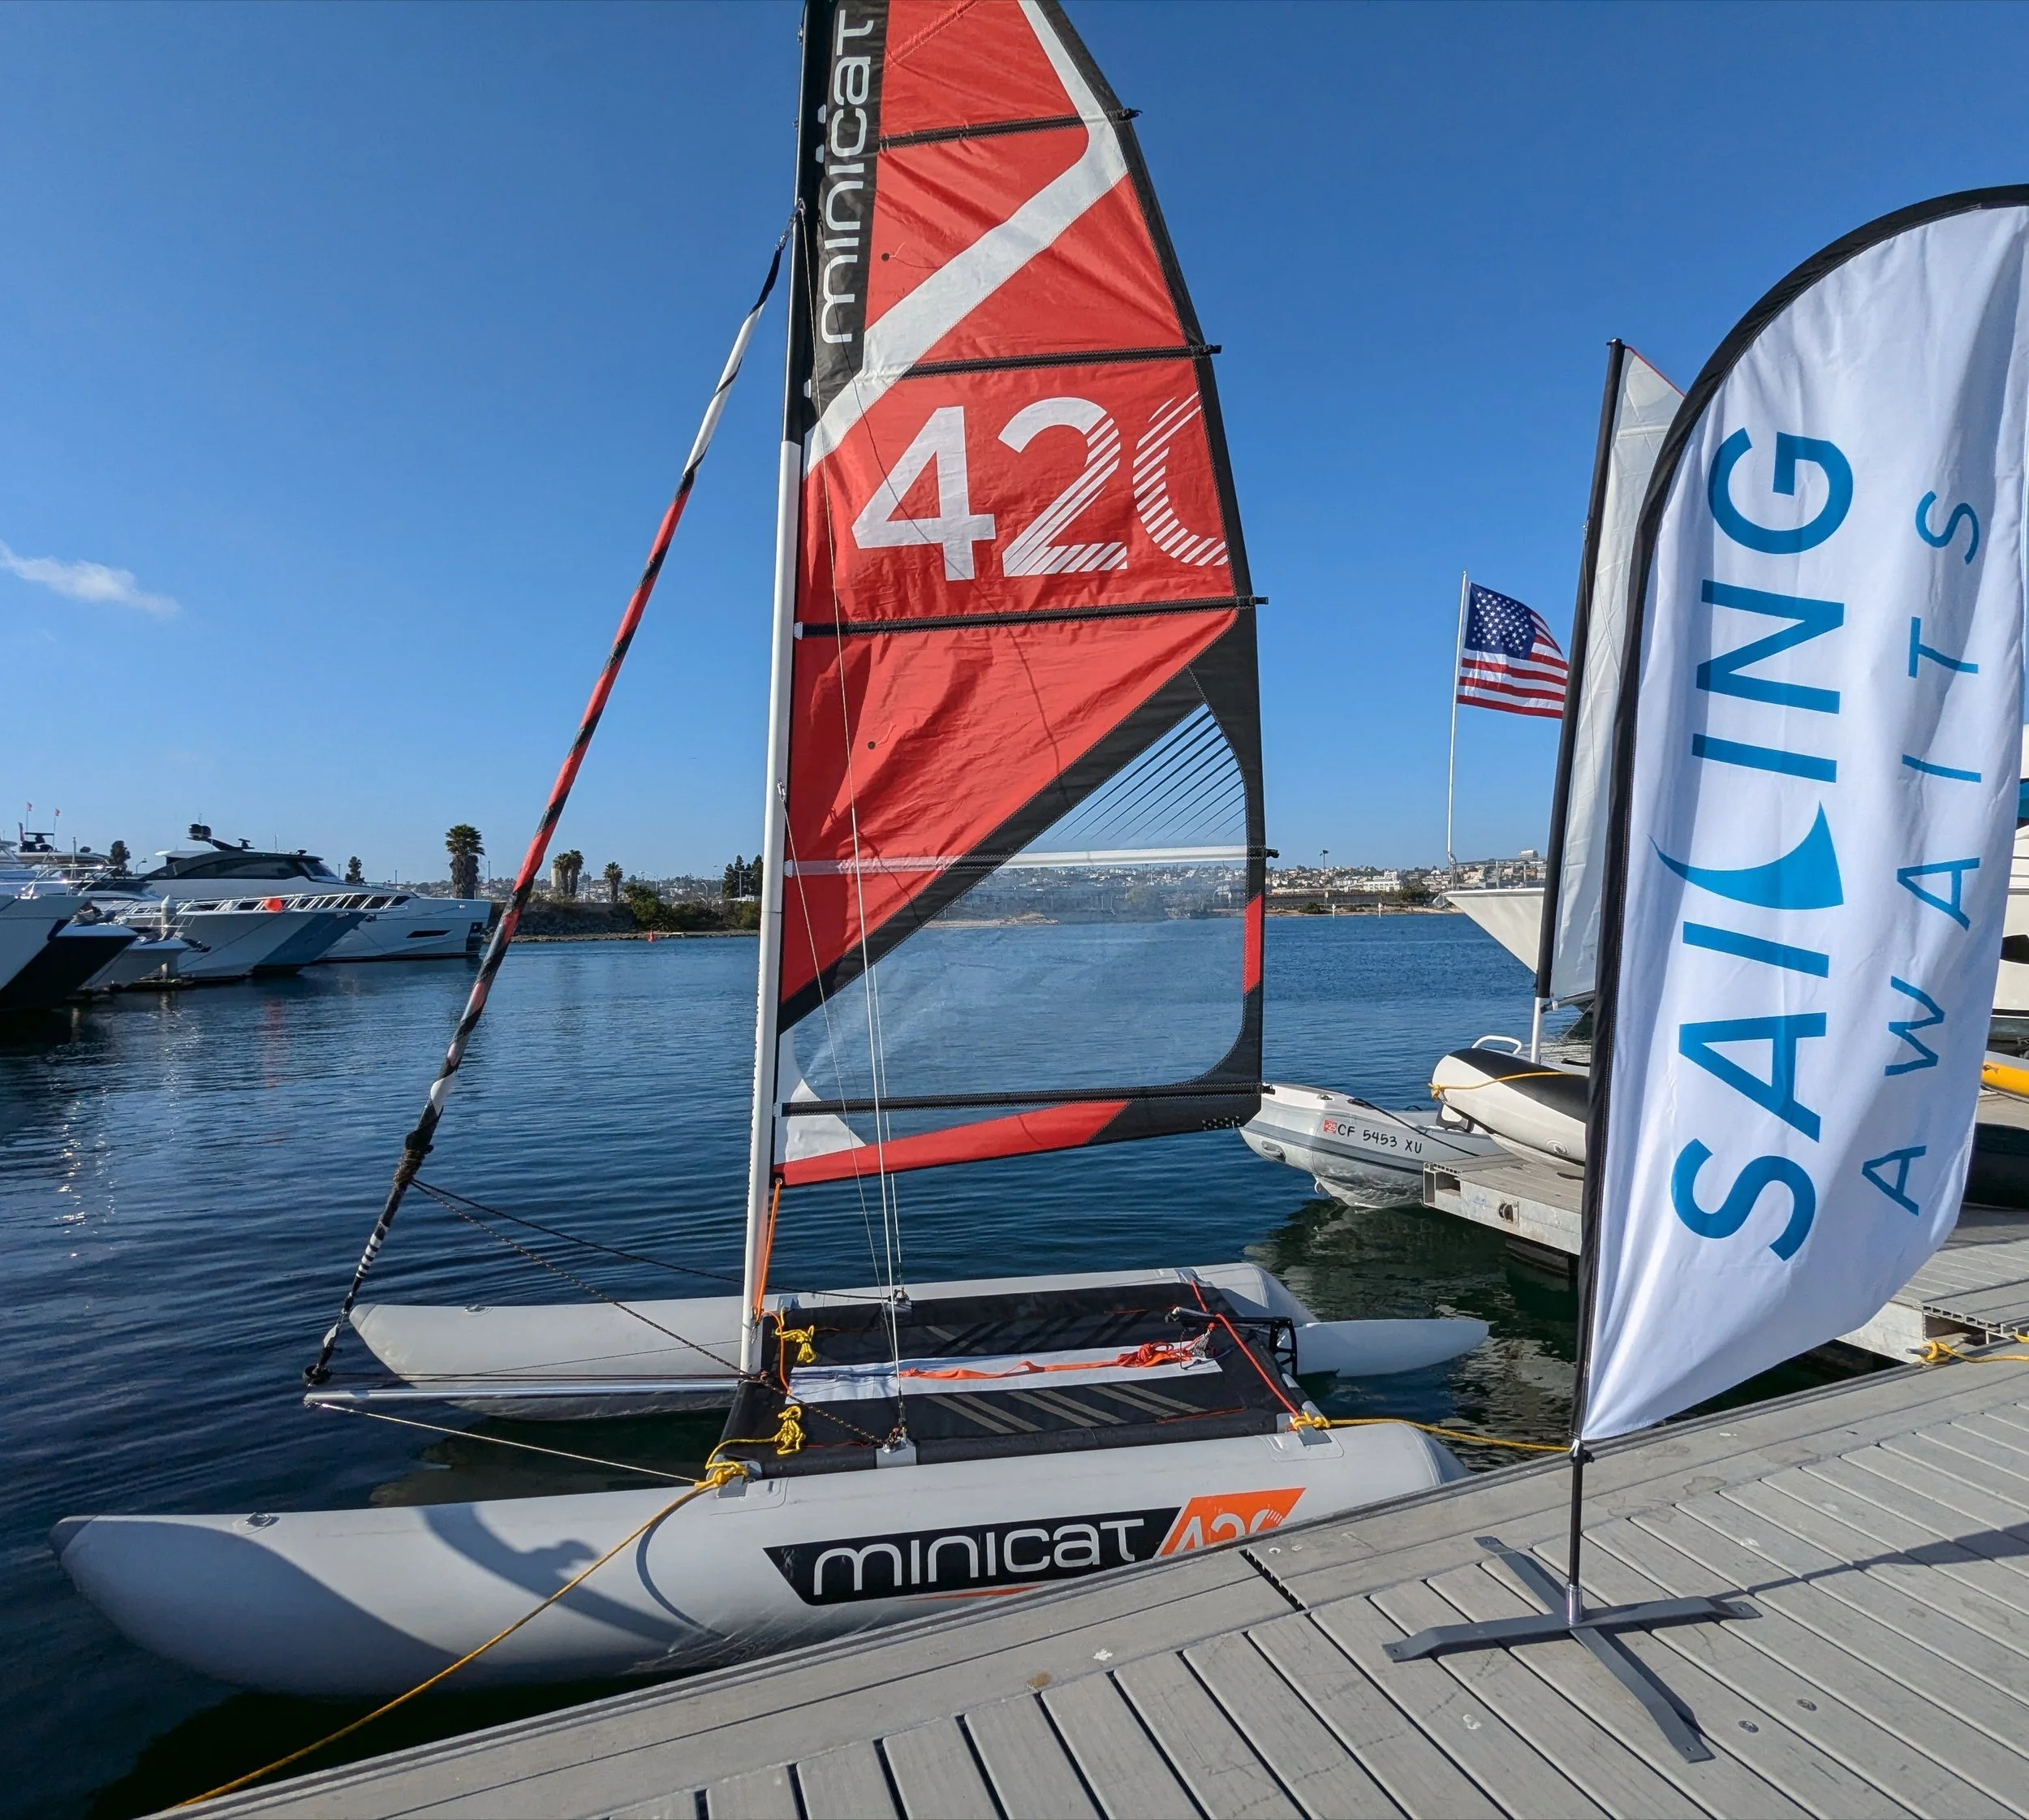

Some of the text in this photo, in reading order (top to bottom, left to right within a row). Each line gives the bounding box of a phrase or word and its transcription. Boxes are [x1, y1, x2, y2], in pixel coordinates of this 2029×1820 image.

[1338, 1123, 1423, 1154] CF 5453 XU
[1648, 427, 1855, 1261] SAILING
[1861, 490, 1982, 1217] AWAITS
